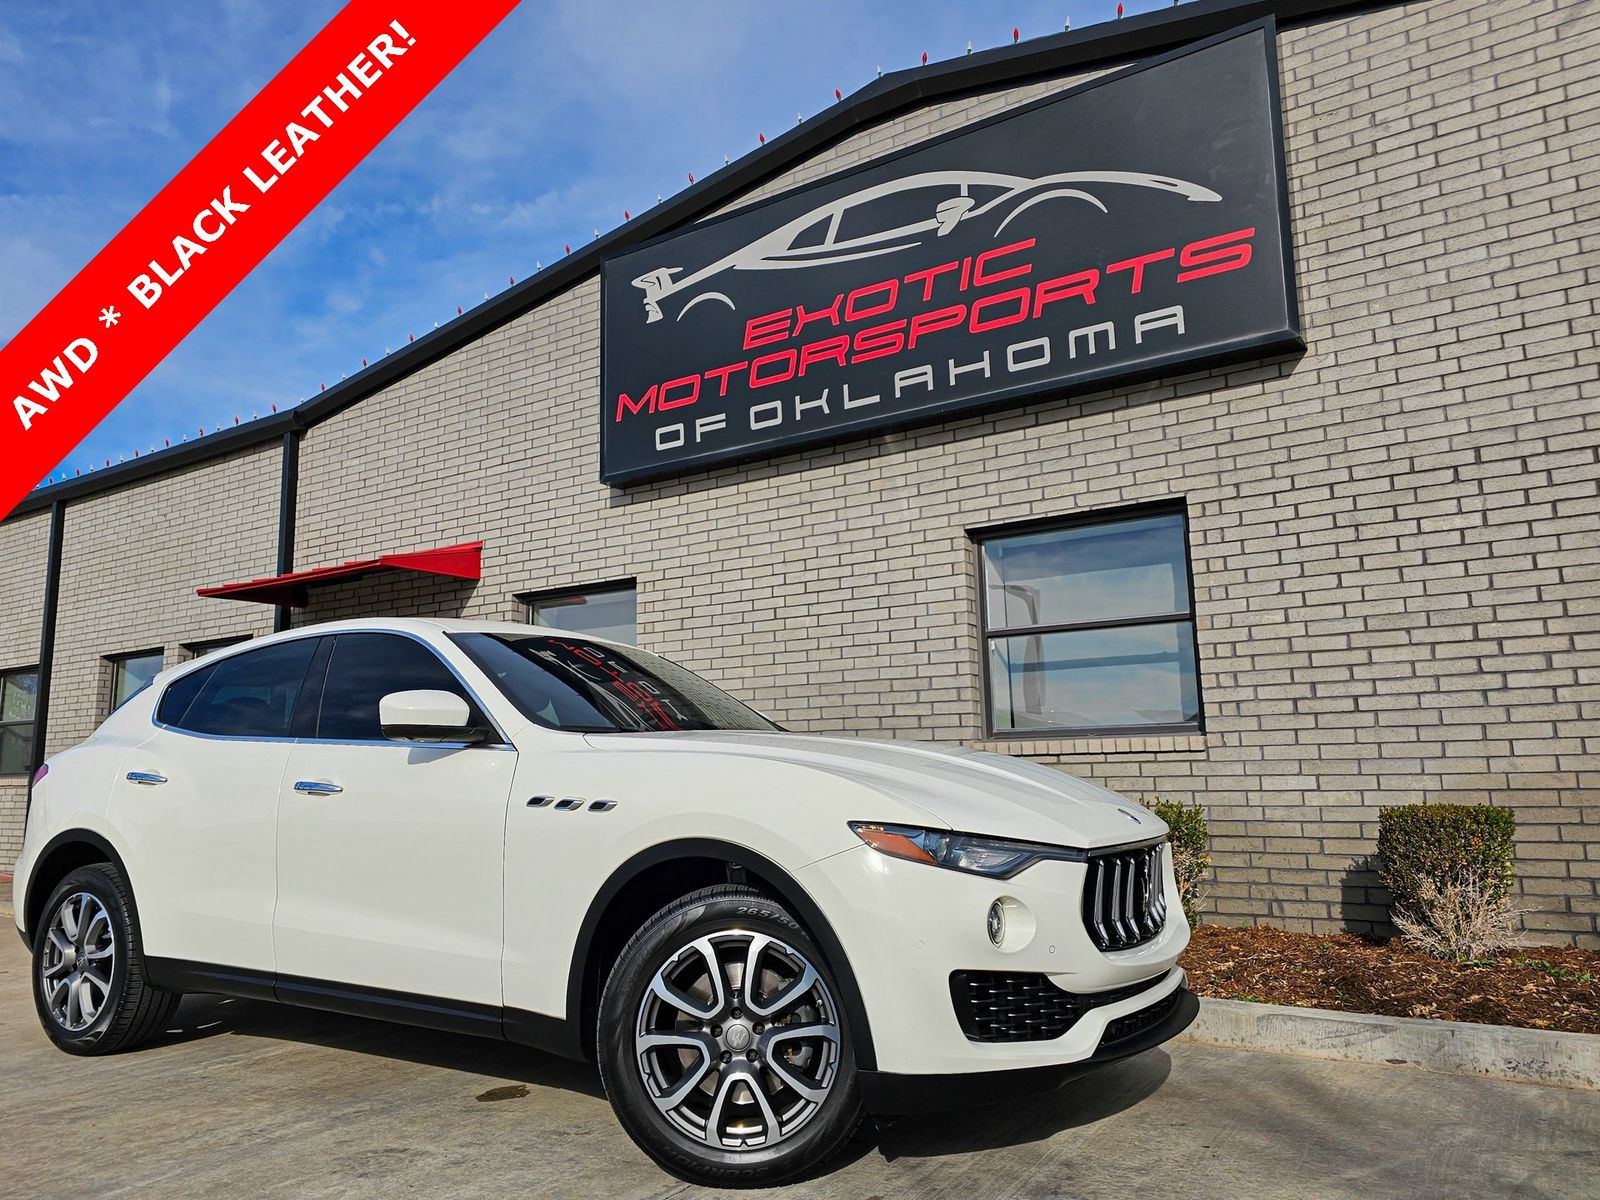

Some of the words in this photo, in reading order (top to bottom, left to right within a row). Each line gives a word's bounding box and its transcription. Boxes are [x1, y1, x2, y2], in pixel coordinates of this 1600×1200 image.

[615, 227, 1255, 422] MOTORSPORTS
[742, 238, 1036, 350] EXOTIC
[655, 412, 727, 451] OF
[749, 304, 1186, 431] OKLAHOMA
